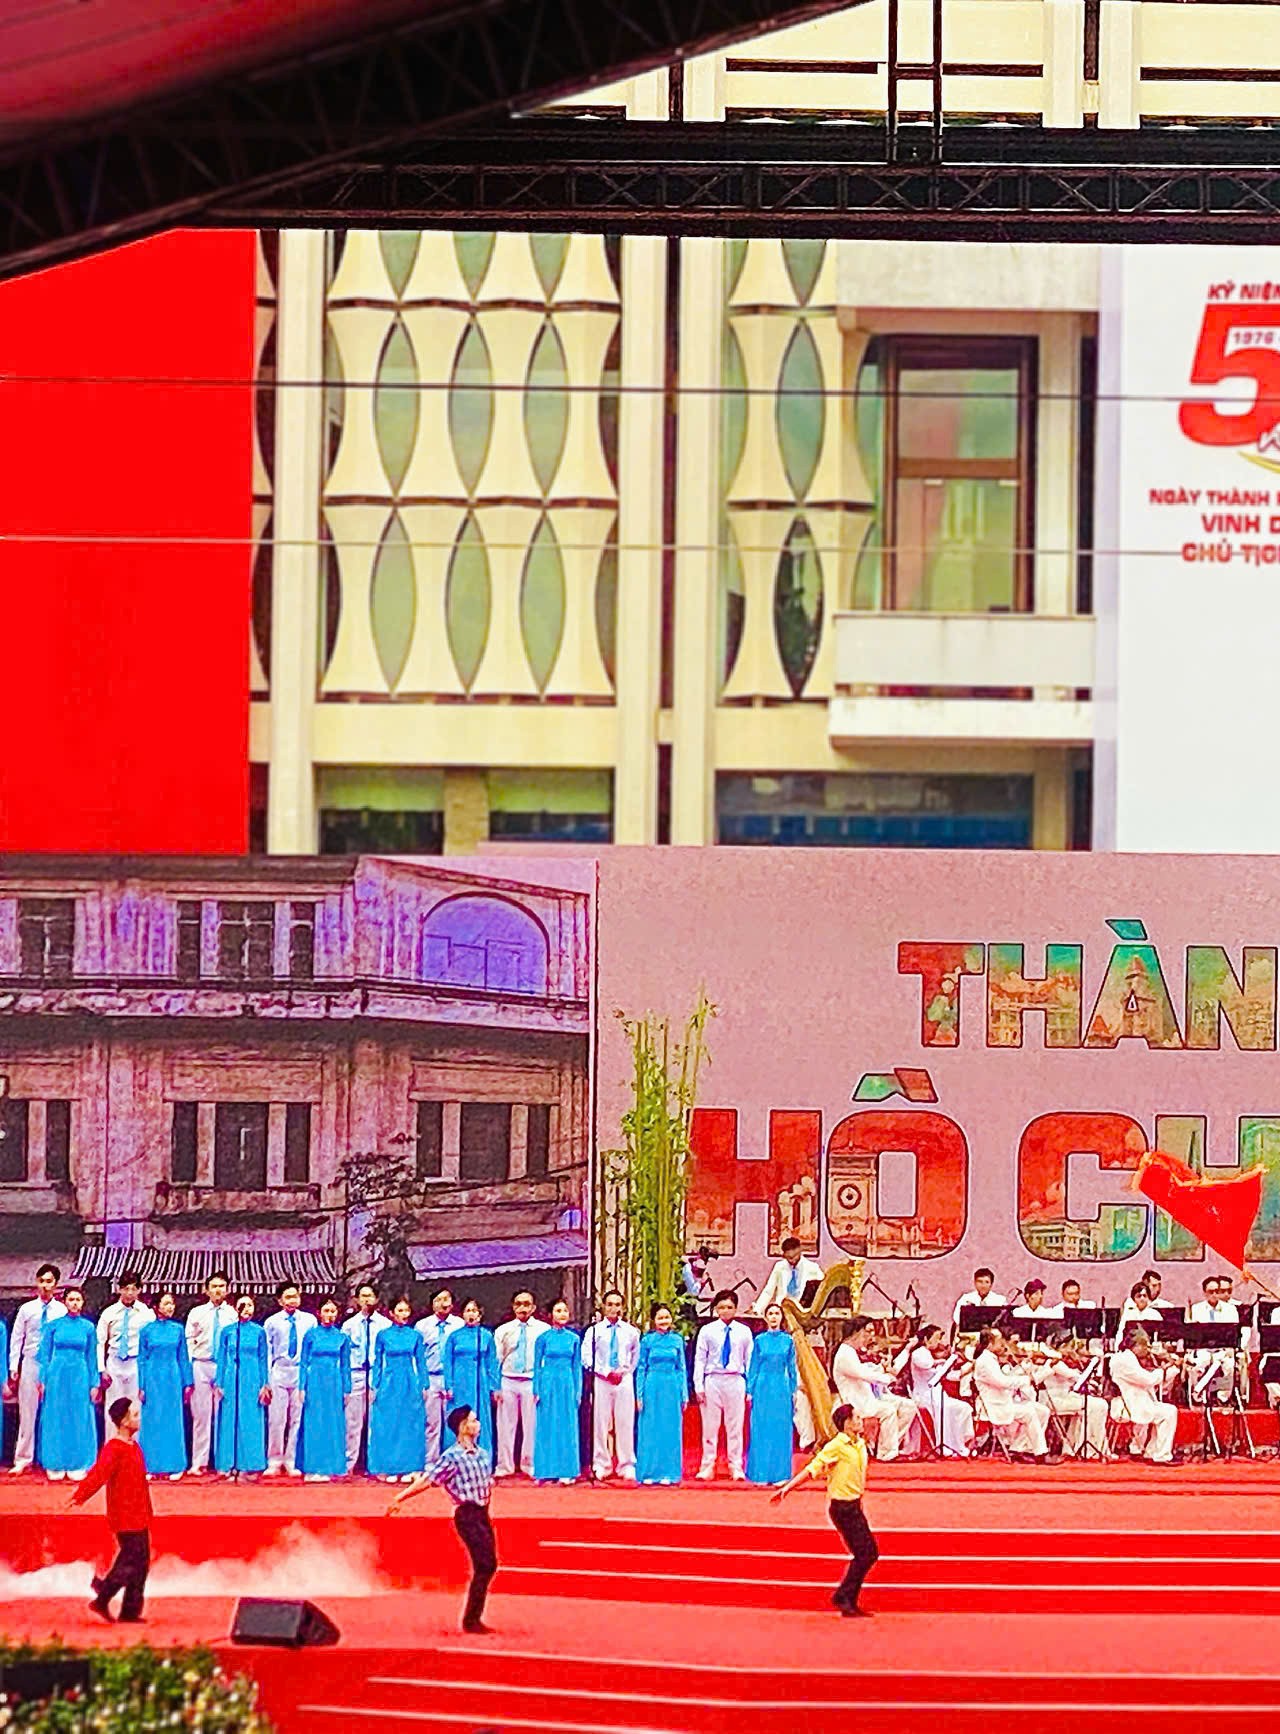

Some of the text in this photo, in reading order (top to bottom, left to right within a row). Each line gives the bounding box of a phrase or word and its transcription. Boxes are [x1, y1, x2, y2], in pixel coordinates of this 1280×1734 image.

[1208, 280, 1235, 300] KỲ
[1233, 331, 1273, 345] 1976
[1149, 486, 1200, 506] NGÀY
[1206, 487, 1269, 507] THÀNH
[1202, 514, 1260, 534] VINH
[1182, 537, 1232, 563] CHỦ
[686, 1067, 971, 1260] HỒ
